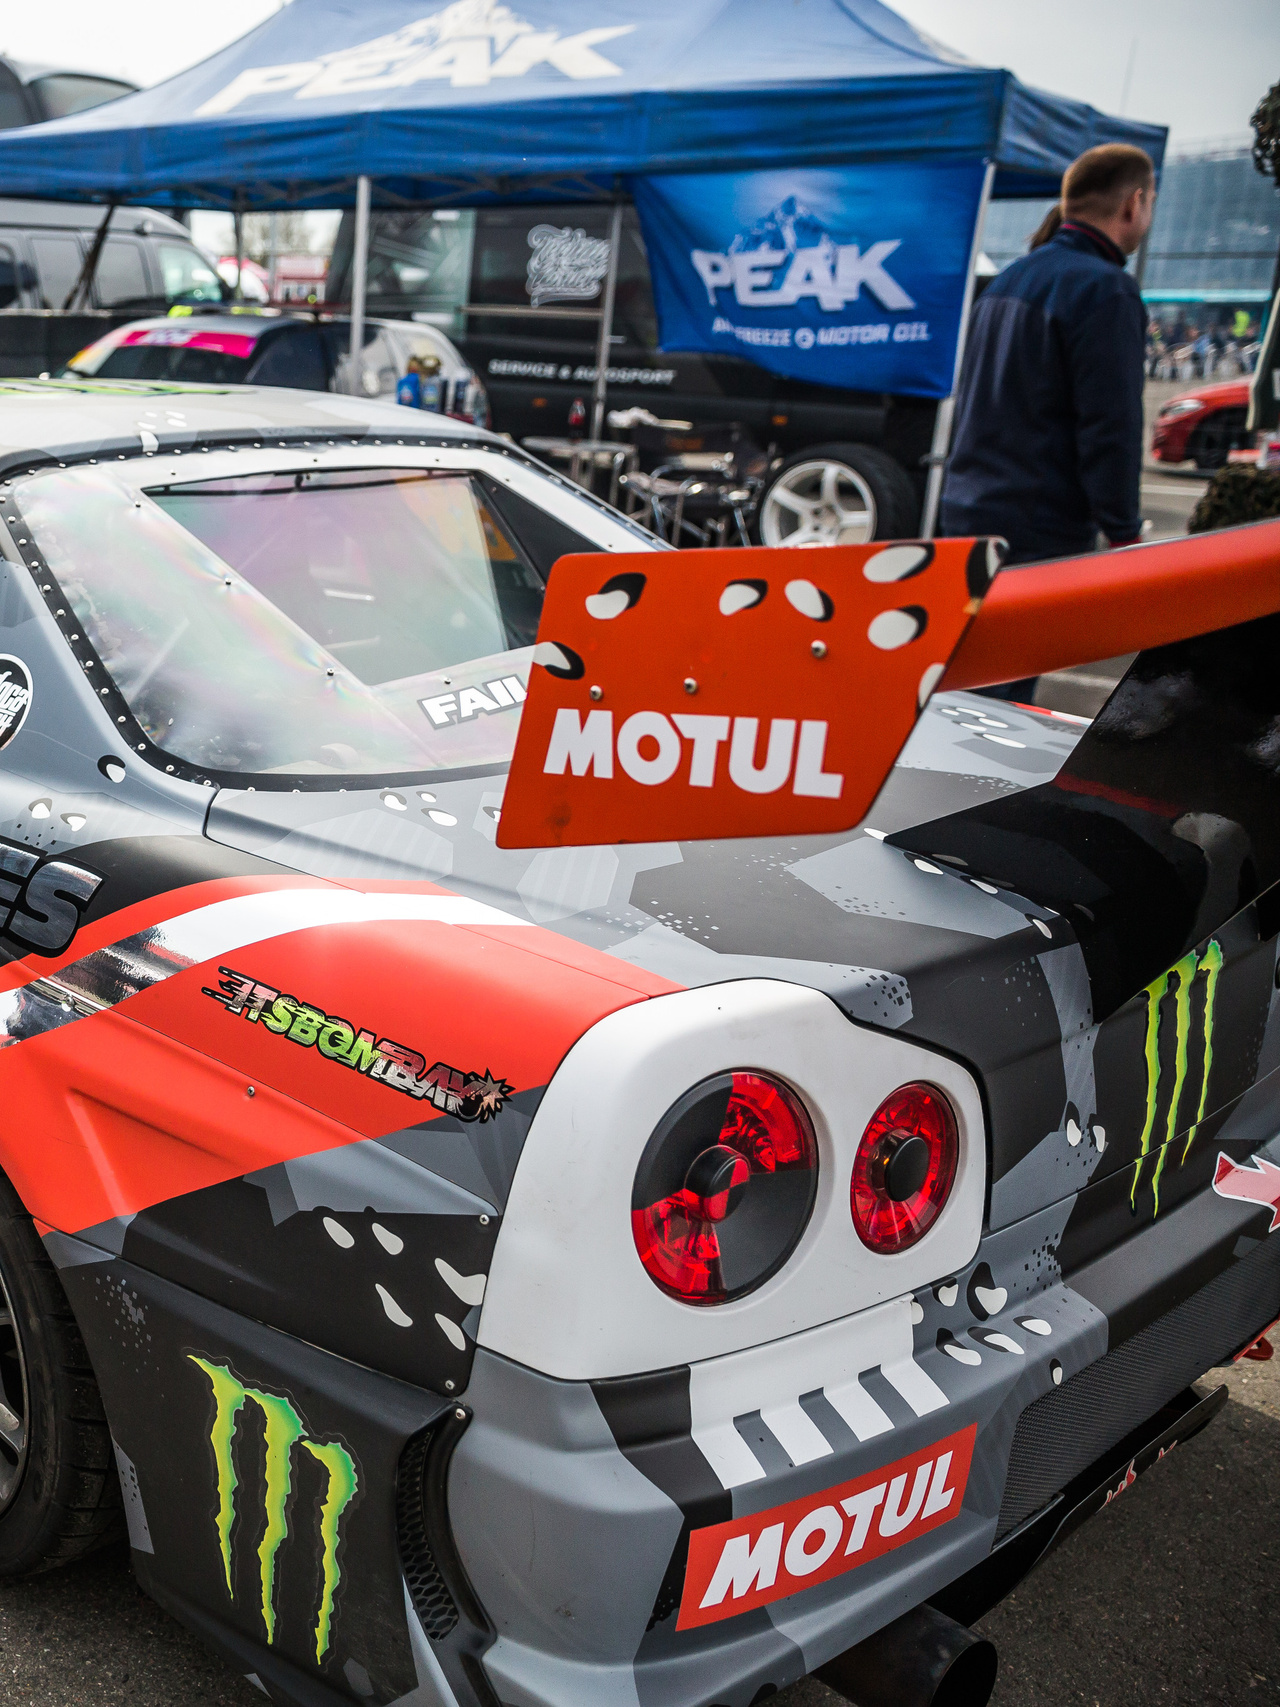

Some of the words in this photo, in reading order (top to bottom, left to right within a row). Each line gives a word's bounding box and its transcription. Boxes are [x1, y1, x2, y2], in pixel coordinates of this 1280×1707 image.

[194, 25, 637, 117] PEAK
[690, 239, 917, 311] PEAK
[488, 358, 558, 378] SERVICE
[573, 365, 676, 385] AUOSPORT
[816, 323, 890, 346] MOTOR
[892, 321, 929, 342] OIL
[543, 708, 844, 799] MOTUL
[698, 1450, 956, 1609] MOTUL
